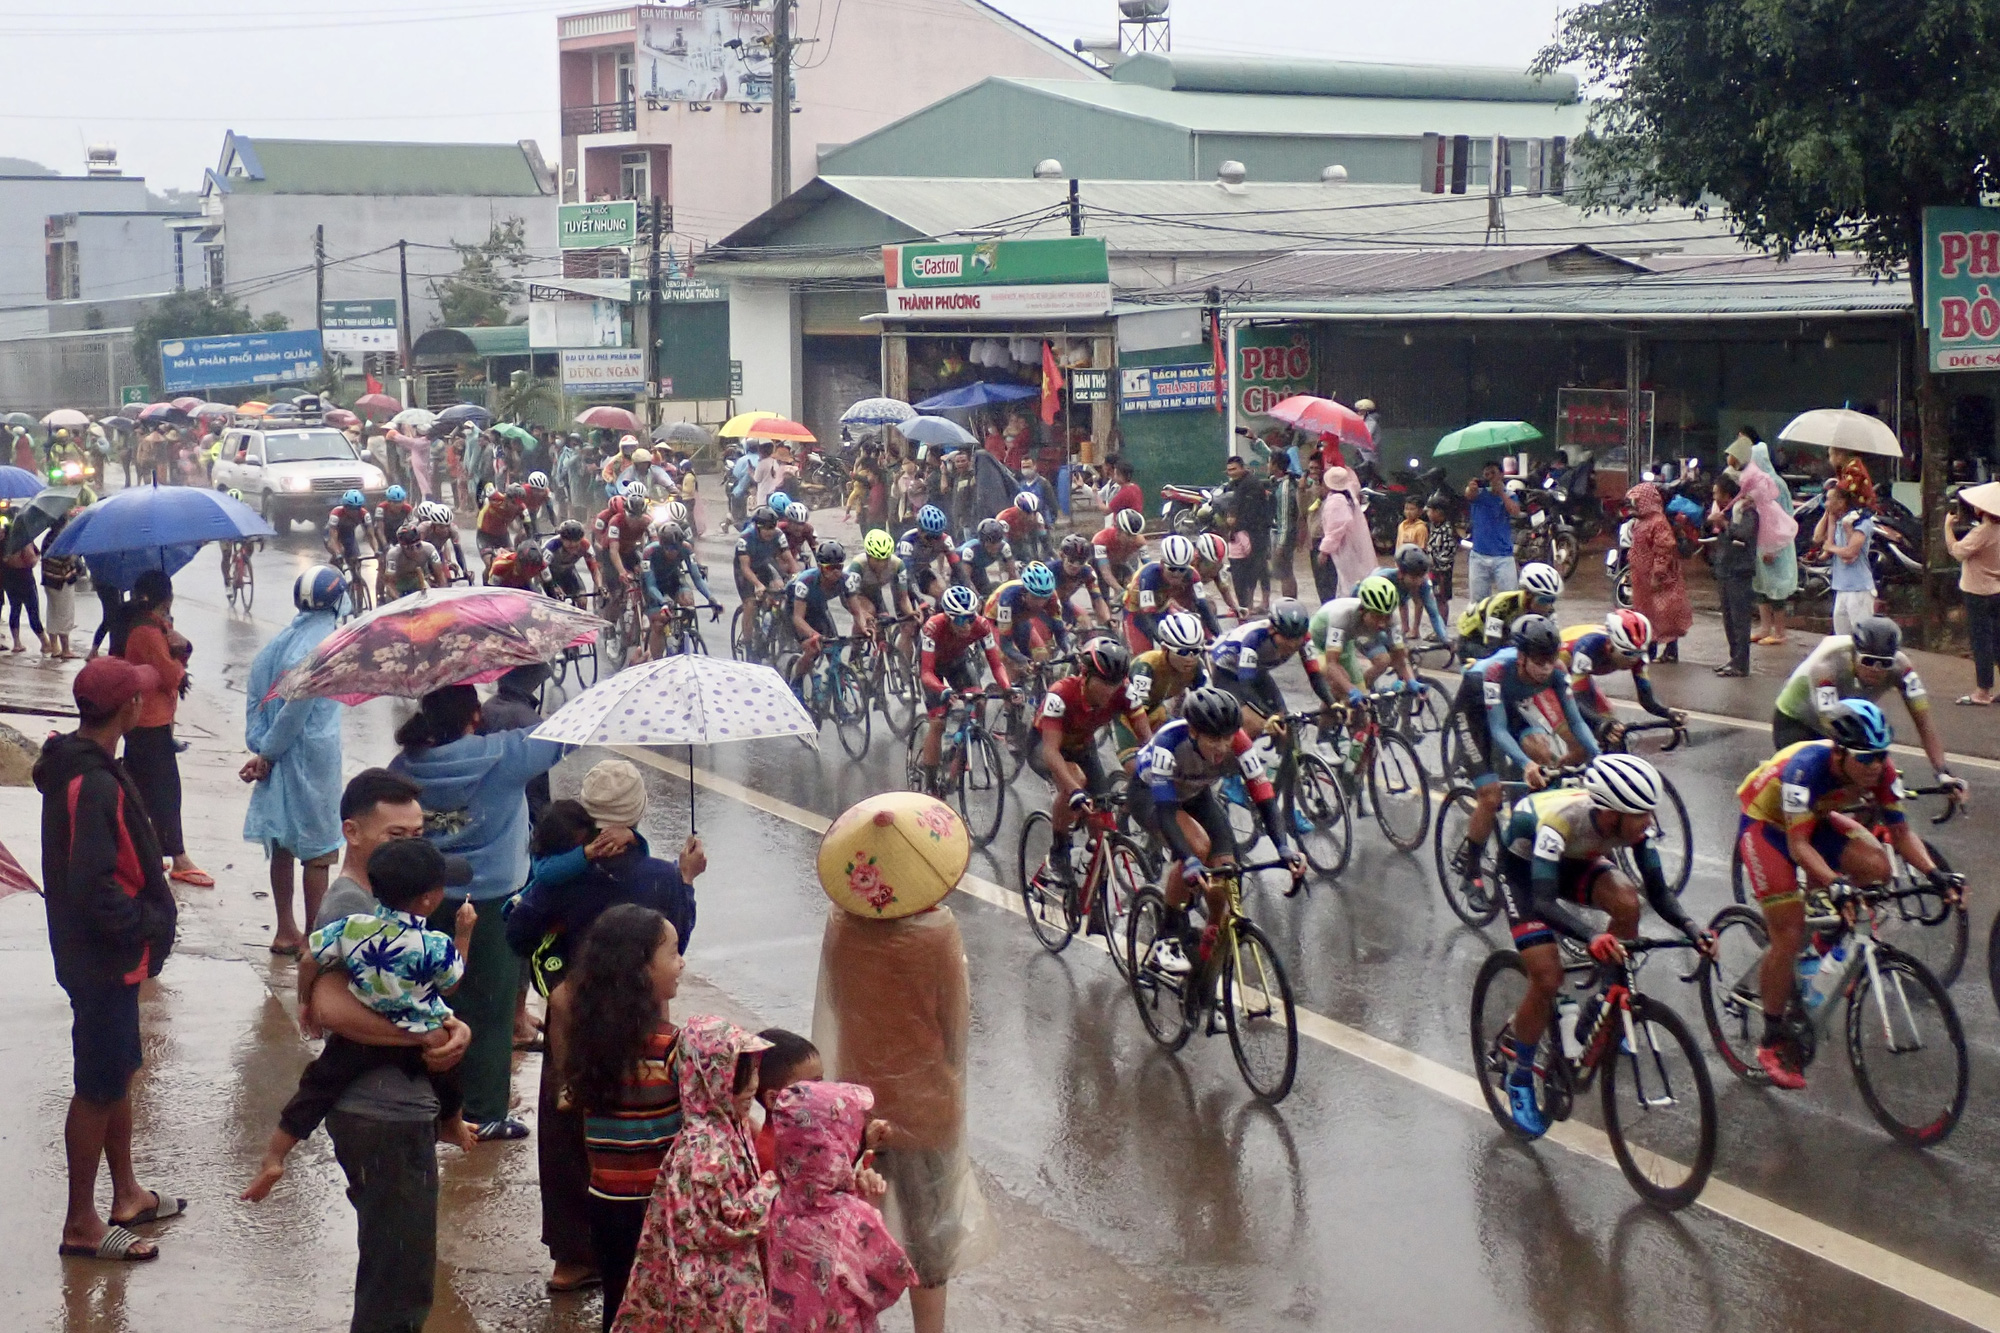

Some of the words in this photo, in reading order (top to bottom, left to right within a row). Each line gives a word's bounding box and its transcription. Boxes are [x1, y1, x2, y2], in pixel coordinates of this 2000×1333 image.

[594, 218, 627, 232] NHUNG
[1940, 233, 2000, 277] PH
[924, 257, 960, 275] Castrol
[898, 293, 934, 311] THÀNH
[1940, 285, 2000, 339] BÒ
[173, 357, 196, 369] NHÀ
[1240, 333, 1311, 380] PHỞ
[1152, 368, 1178, 380] BÁCH
[1047, 699, 1061, 713] 82
